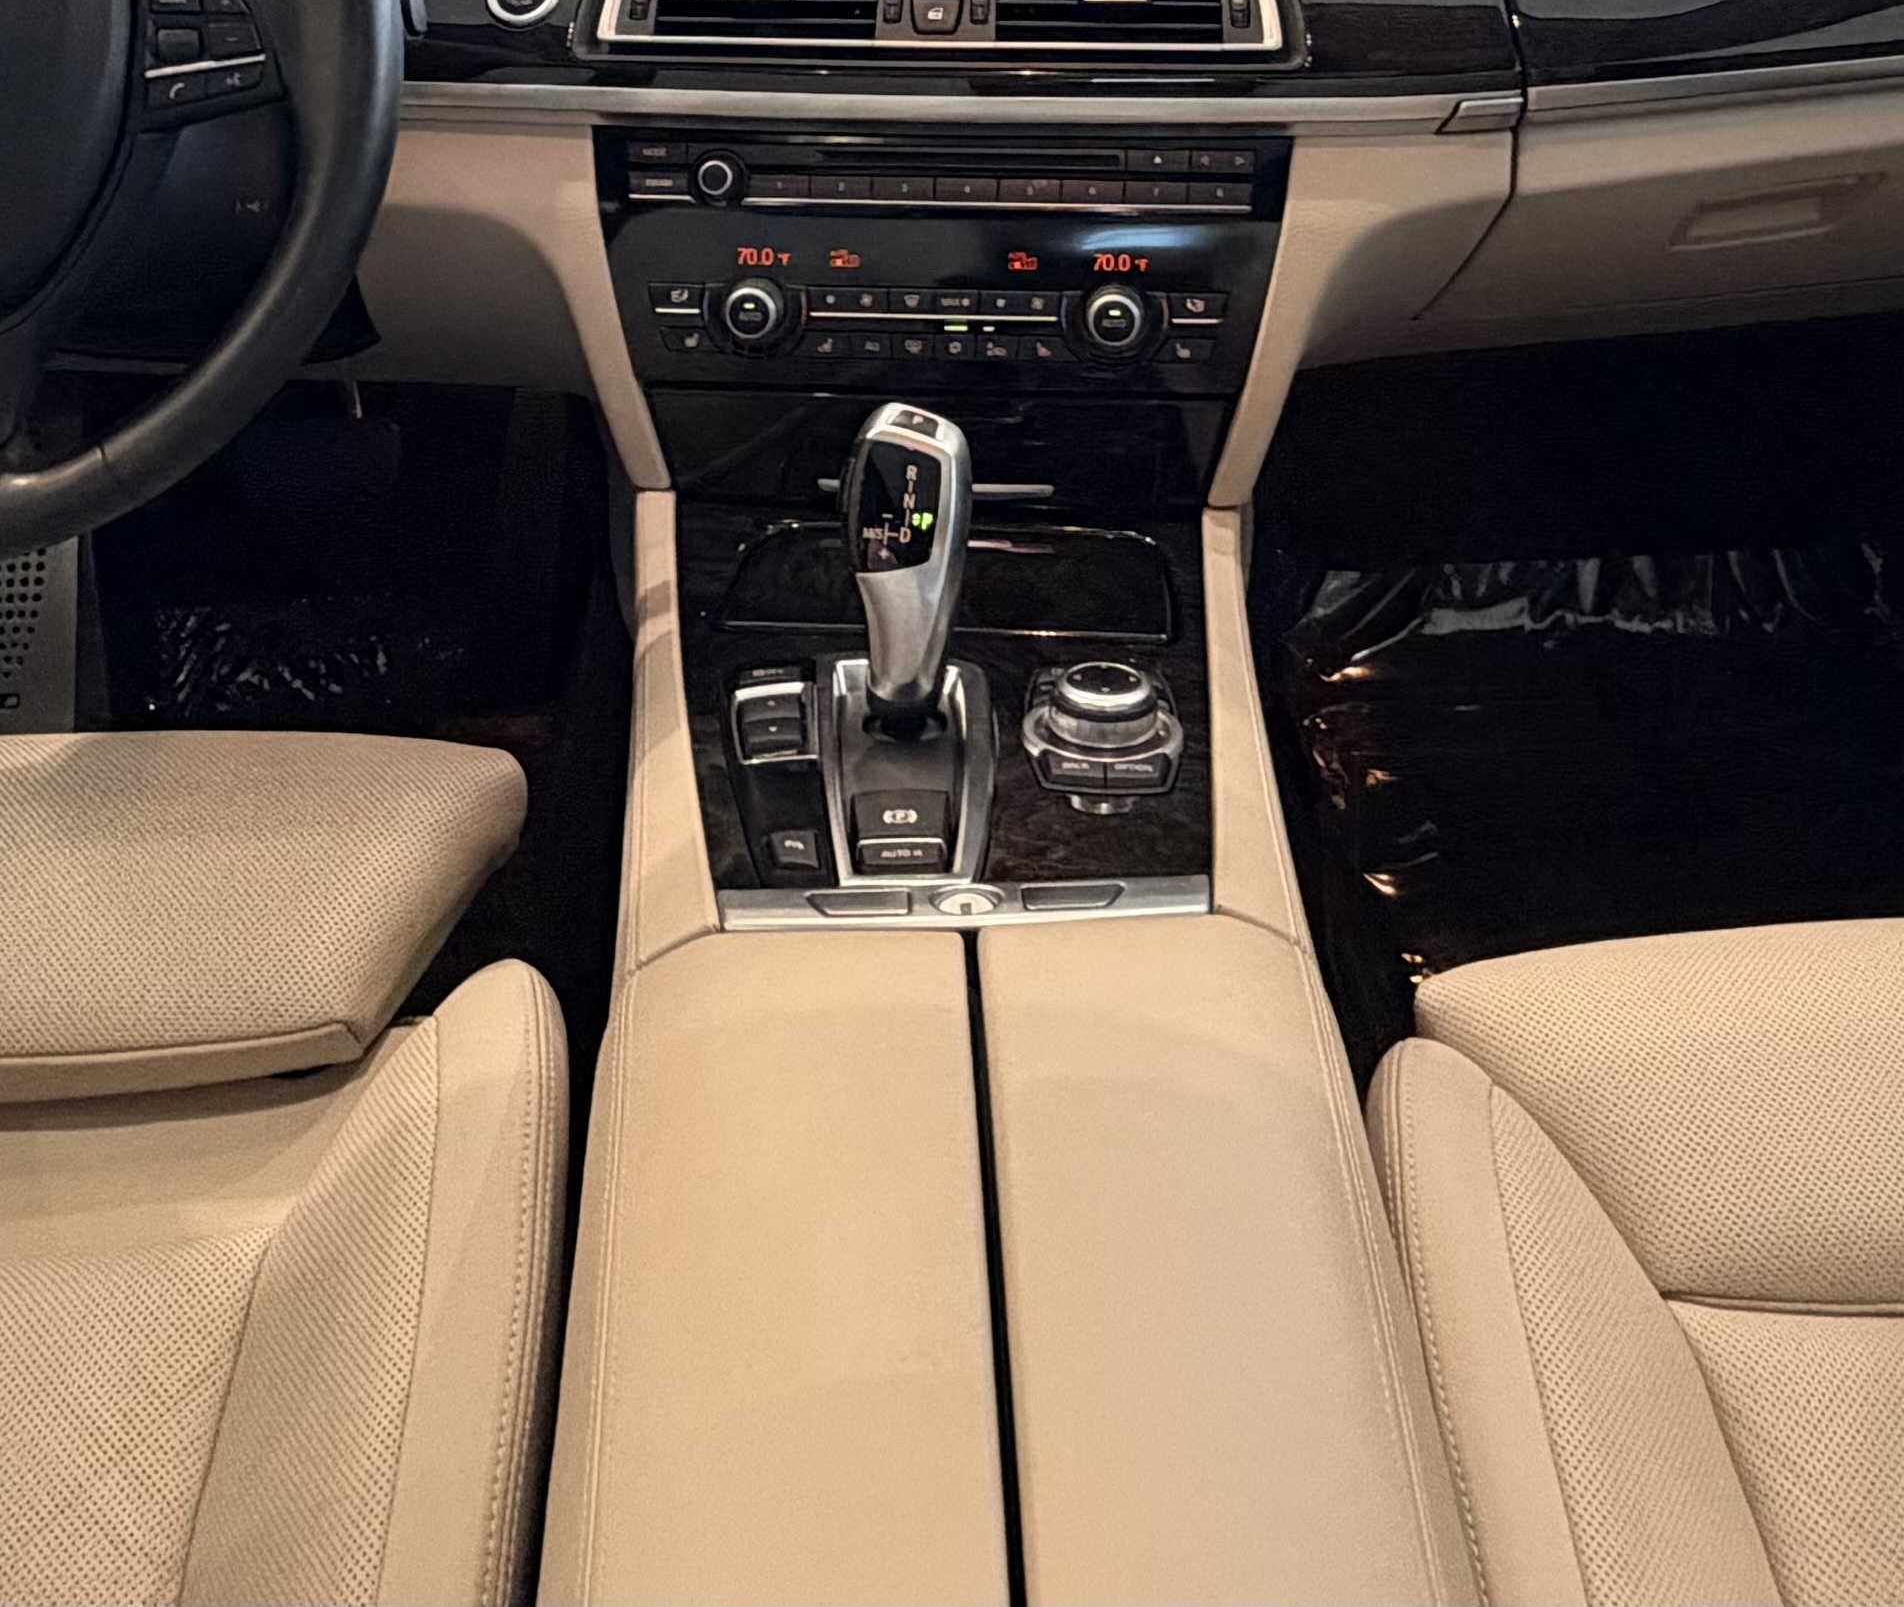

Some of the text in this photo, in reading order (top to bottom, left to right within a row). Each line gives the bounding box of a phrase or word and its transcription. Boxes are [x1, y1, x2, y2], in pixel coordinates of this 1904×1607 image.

[737, 247, 775, 266] 70.0
[1093, 253, 1132, 272] 70.0
[906, 465, 918, 481] R
[903, 493, 916, 509] N
[899, 527, 912, 543] D
